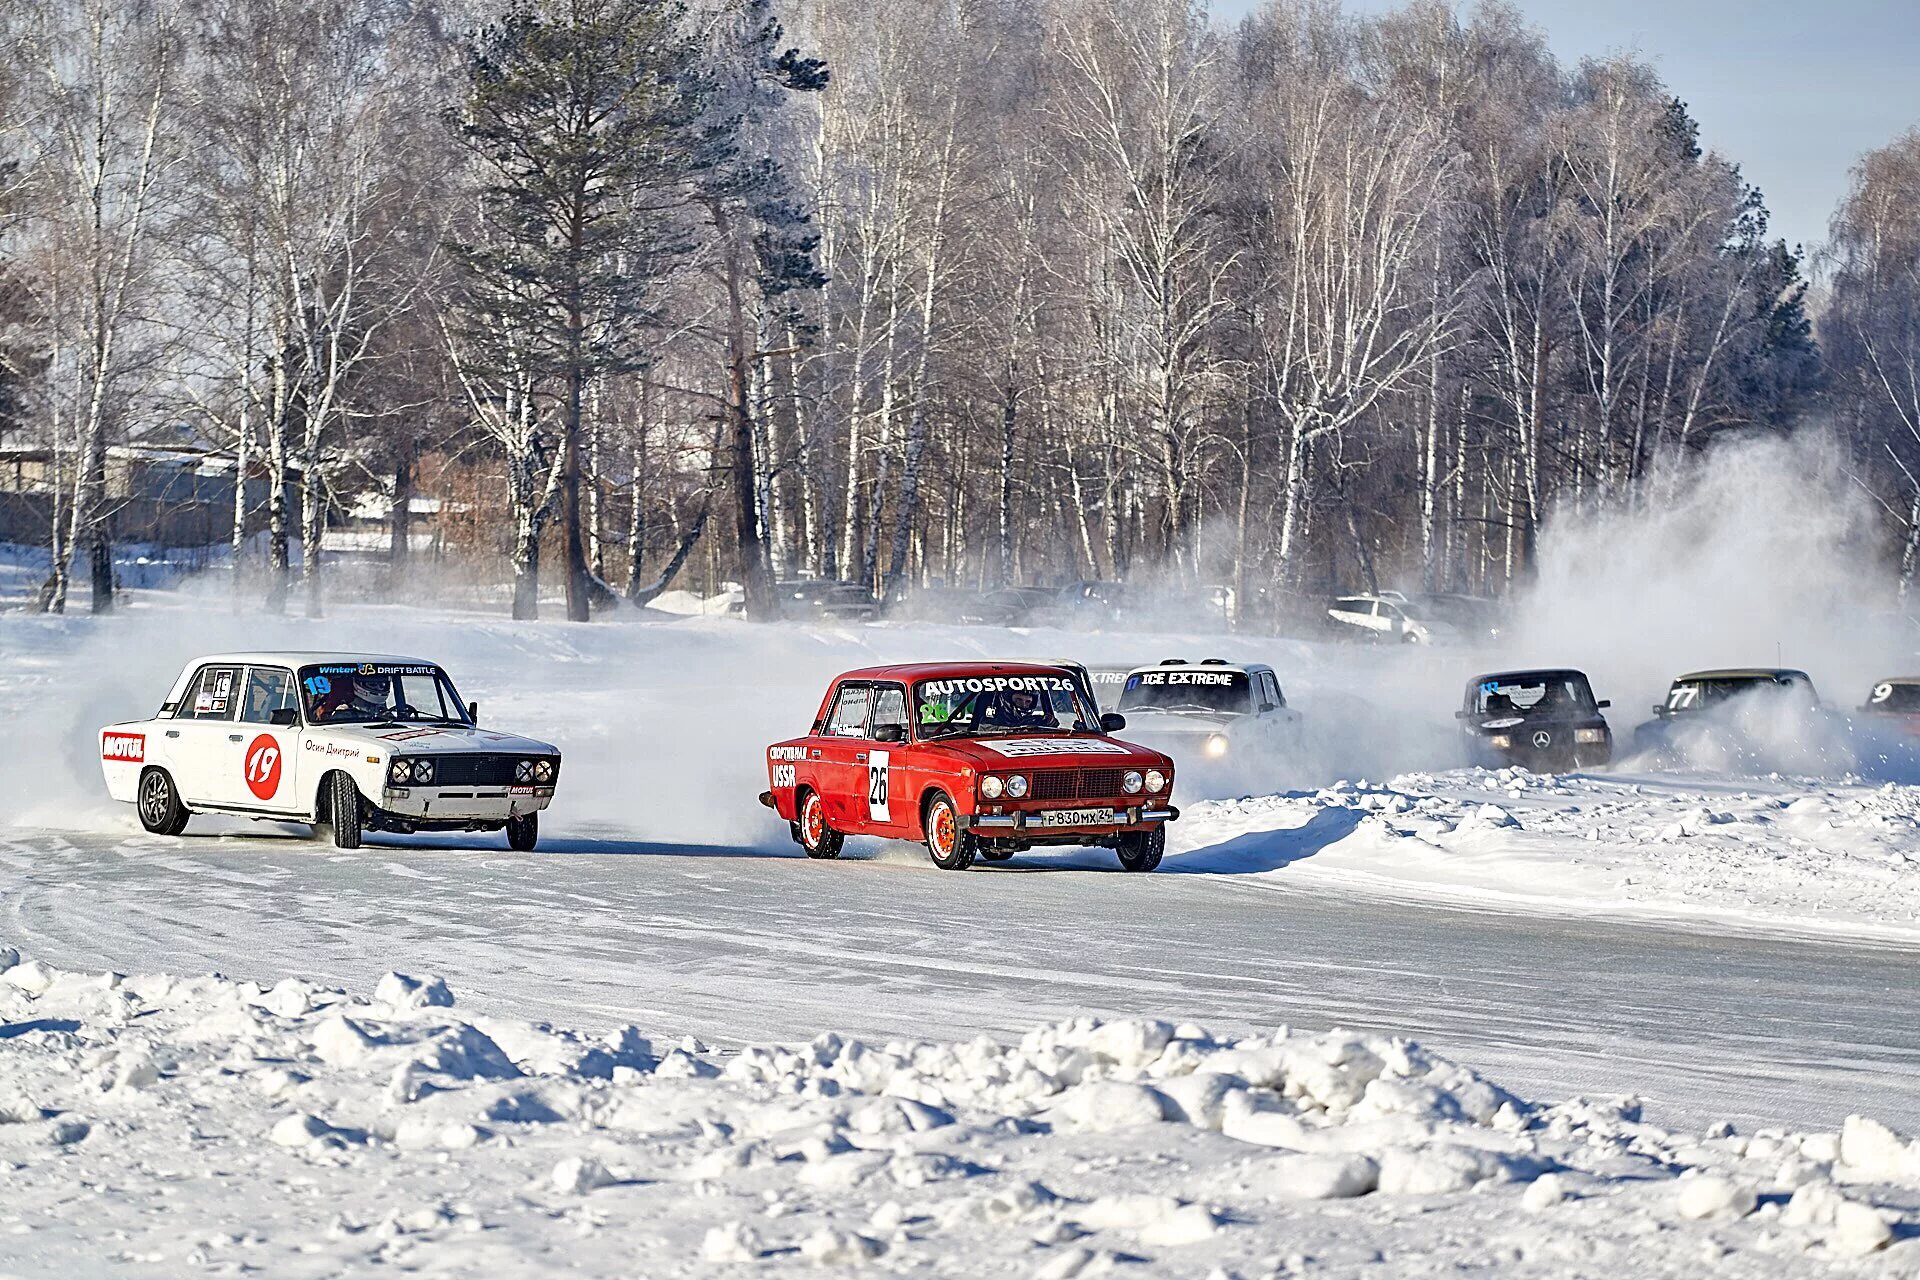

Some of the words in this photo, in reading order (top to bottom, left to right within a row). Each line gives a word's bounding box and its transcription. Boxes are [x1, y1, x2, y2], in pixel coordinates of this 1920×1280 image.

[377, 667, 405, 675] DRIFT
[406, 667, 436, 675] BATTLE
[1141, 673, 1165, 685] ICE
[1168, 672, 1233, 686] EXTREME
[213, 677, 231, 698] 19
[304, 676, 332, 696] 19
[925, 677, 1075, 697] AUTOSPORT26
[1872, 683, 1893, 703] 9
[1669, 688, 1699, 709] 77
[920, 703, 949, 724] 26
[103, 736, 145, 759] MOTUL
[305, 740, 325, 752] Осин
[326, 743, 360, 759] Дмитрий
[247, 747, 279, 783] 19
[773, 764, 797, 788] USSR
[870, 766, 887, 805] 26
[511, 786, 534, 794] MOTUL
[1099, 809, 1111, 820] 24
